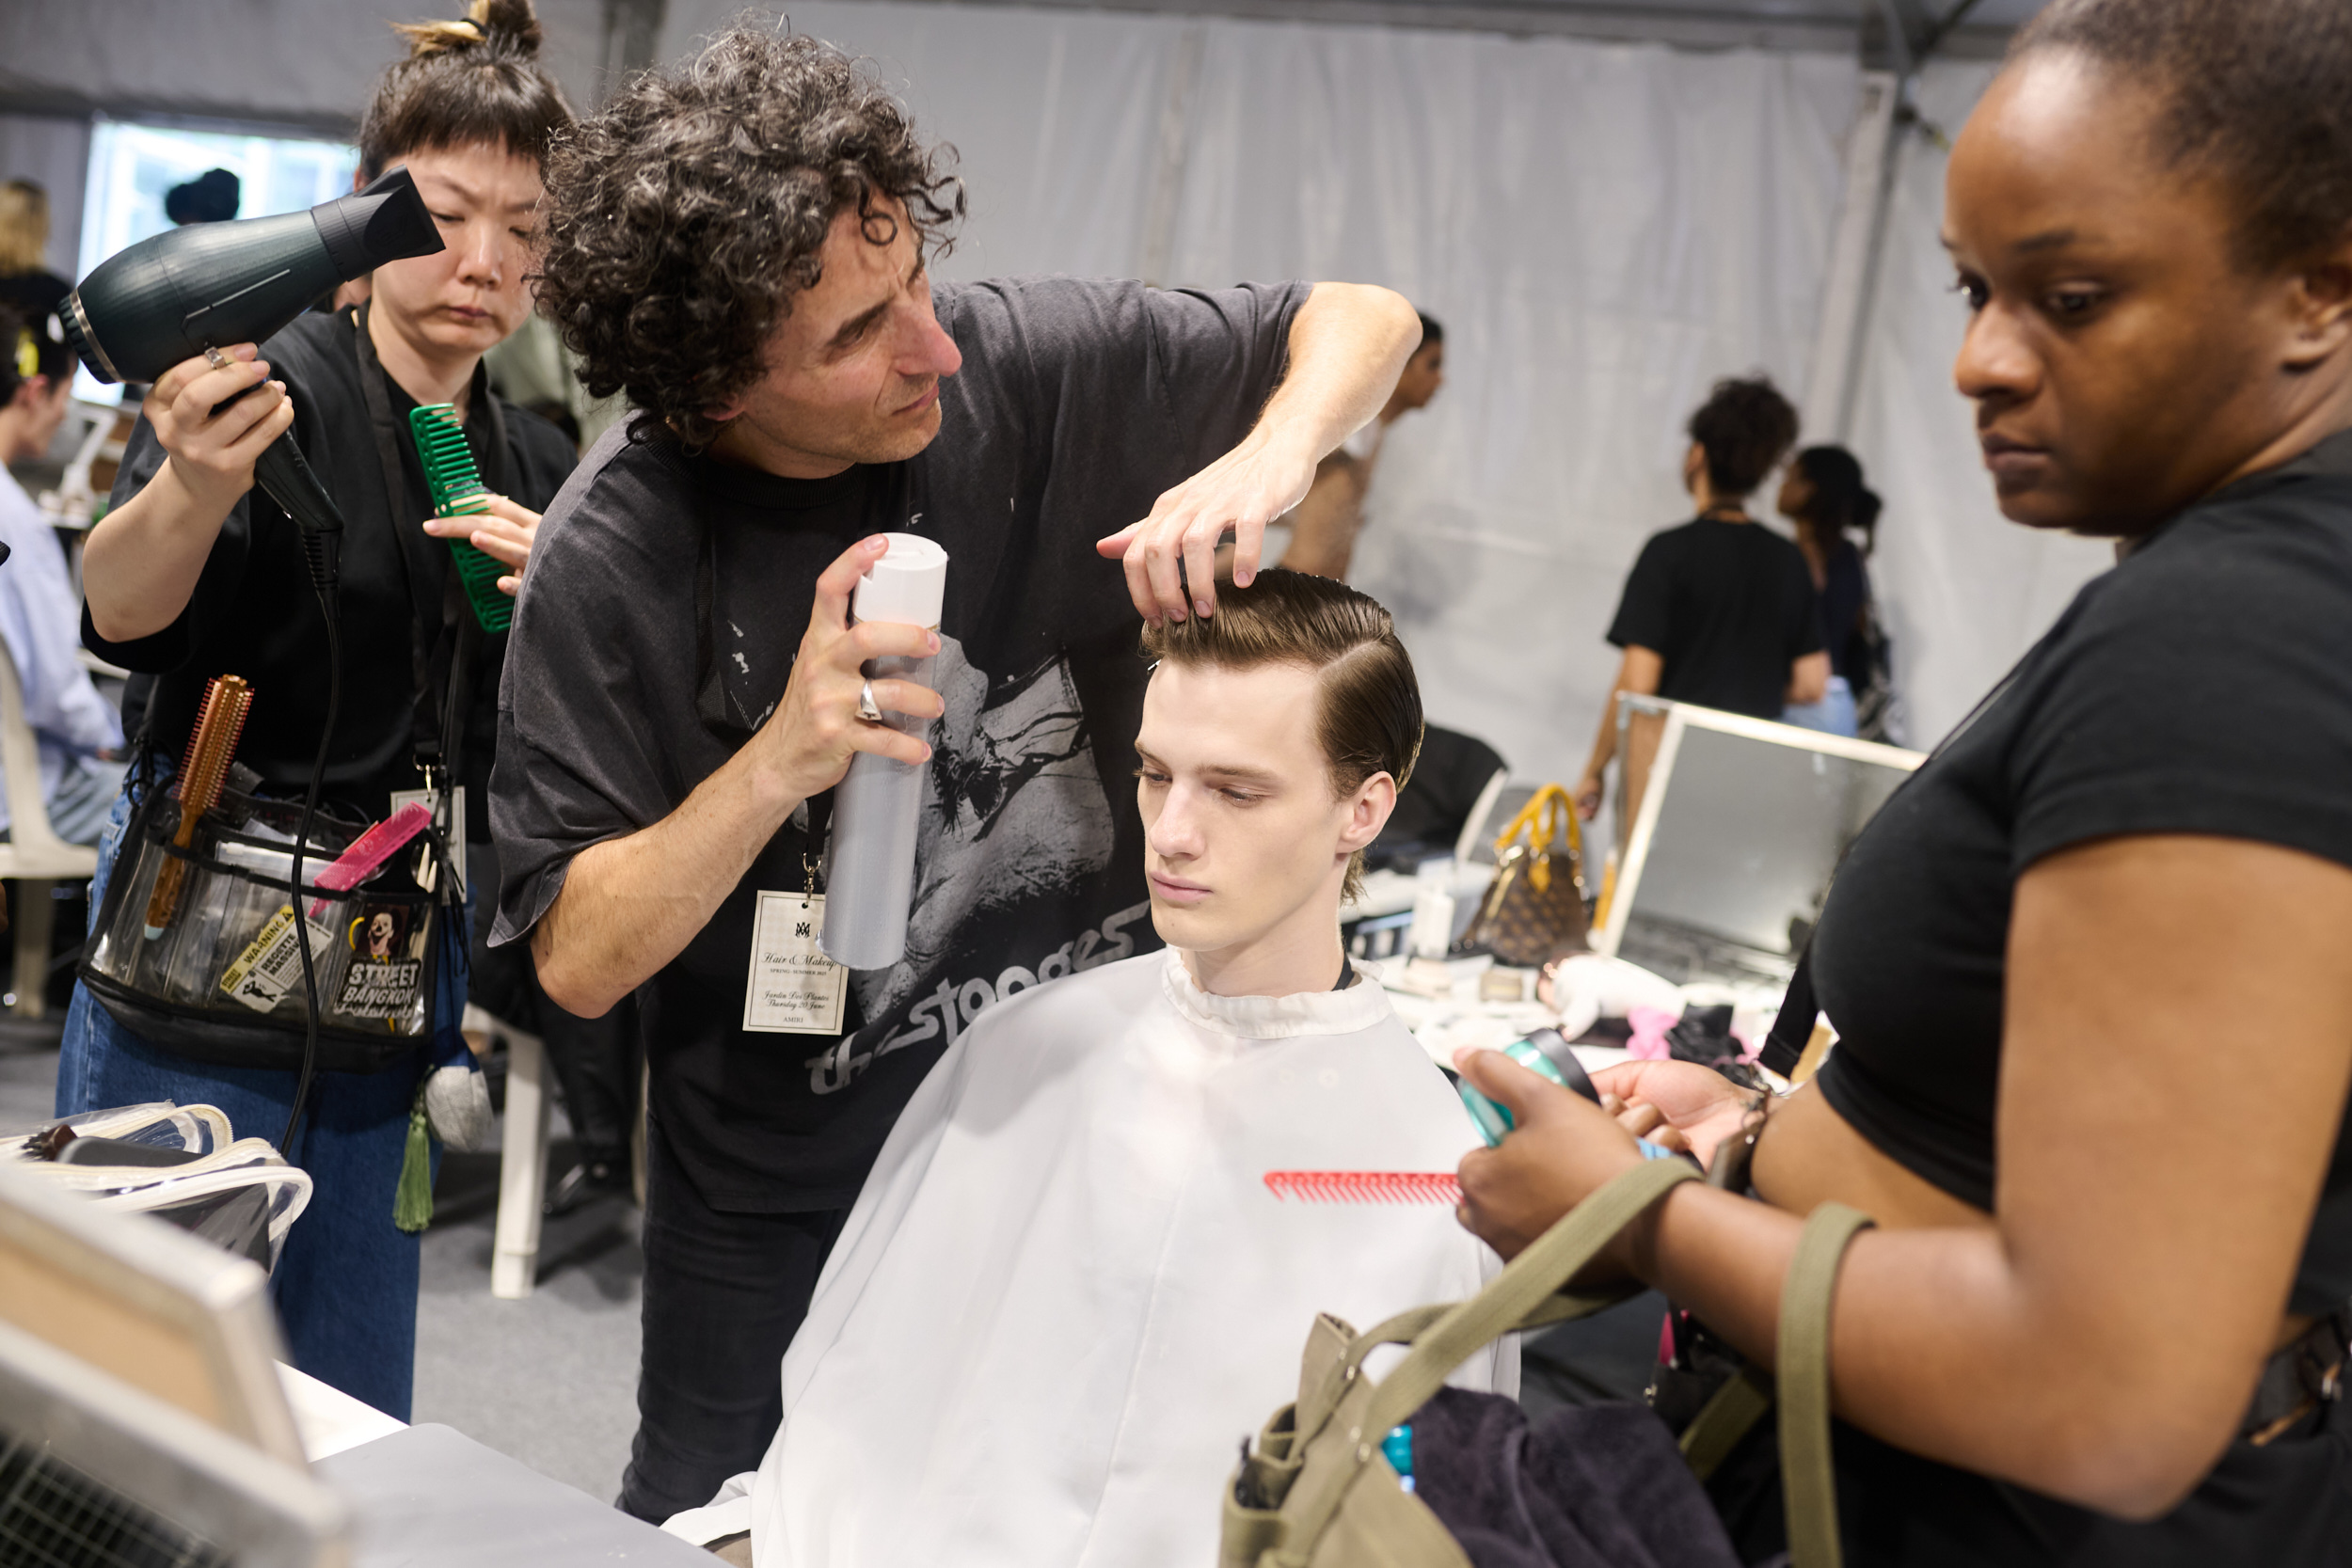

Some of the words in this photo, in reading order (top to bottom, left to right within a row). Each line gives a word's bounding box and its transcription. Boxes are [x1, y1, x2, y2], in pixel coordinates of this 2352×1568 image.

[244, 921, 284, 964] WARNING
[269, 938, 300, 976] MASSIV
[761, 952, 787, 963] Hair
[788, 954, 798, 965] &
[798, 954, 837, 971] Makeup
[349, 963, 418, 988] STREET
[342, 984, 415, 1005] BANGKOK
[762, 990, 787, 1000] Jardin
[788, 990, 803, 1000] Des
[803, 991, 830, 1002] Plantes
[767, 999, 798, 1011] Thursday
[799, 1001, 807, 1009] 20
[806, 1001, 826, 1011] June
[804, 1024, 900, 1095] th
